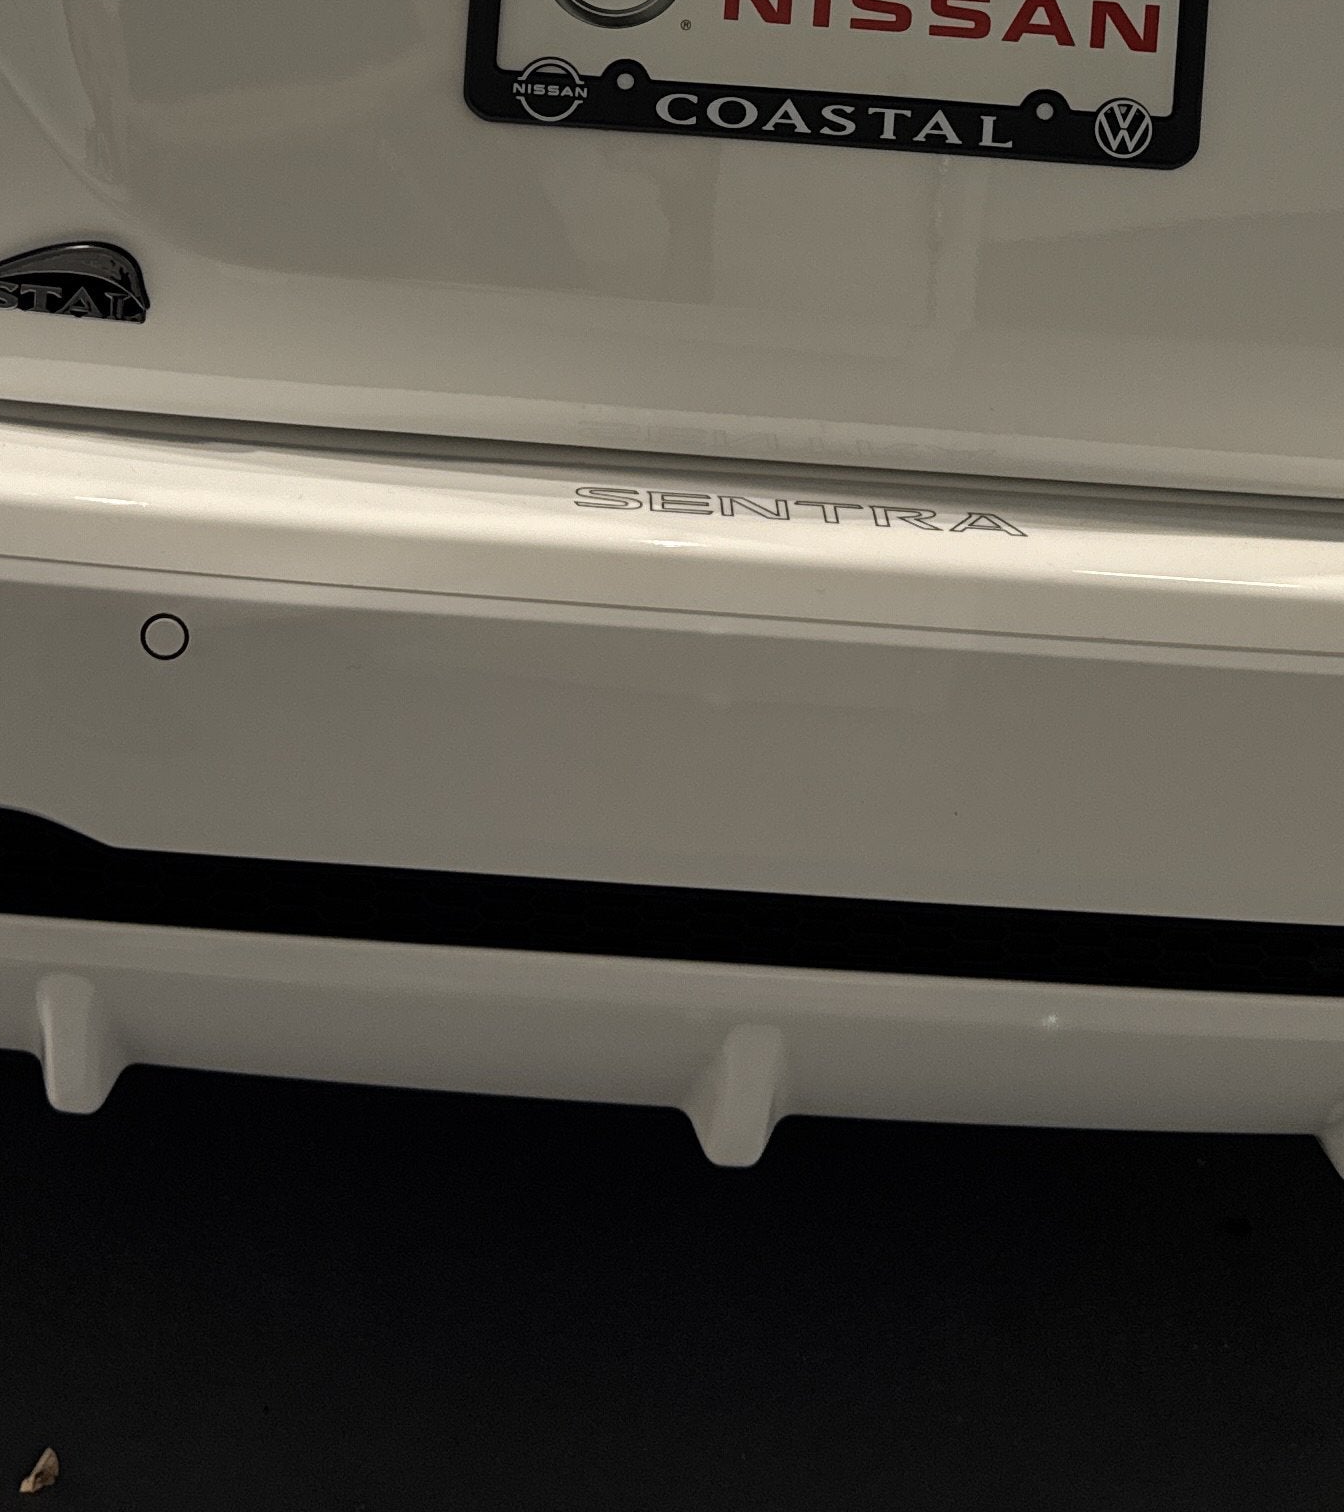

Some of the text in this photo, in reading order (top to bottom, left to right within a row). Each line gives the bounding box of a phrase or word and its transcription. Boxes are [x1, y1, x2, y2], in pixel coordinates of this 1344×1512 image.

[513, 82, 587, 98] NISSAN
[655, 93, 1013, 148] COASTAL
[574, 487, 1029, 538] SENTRA
